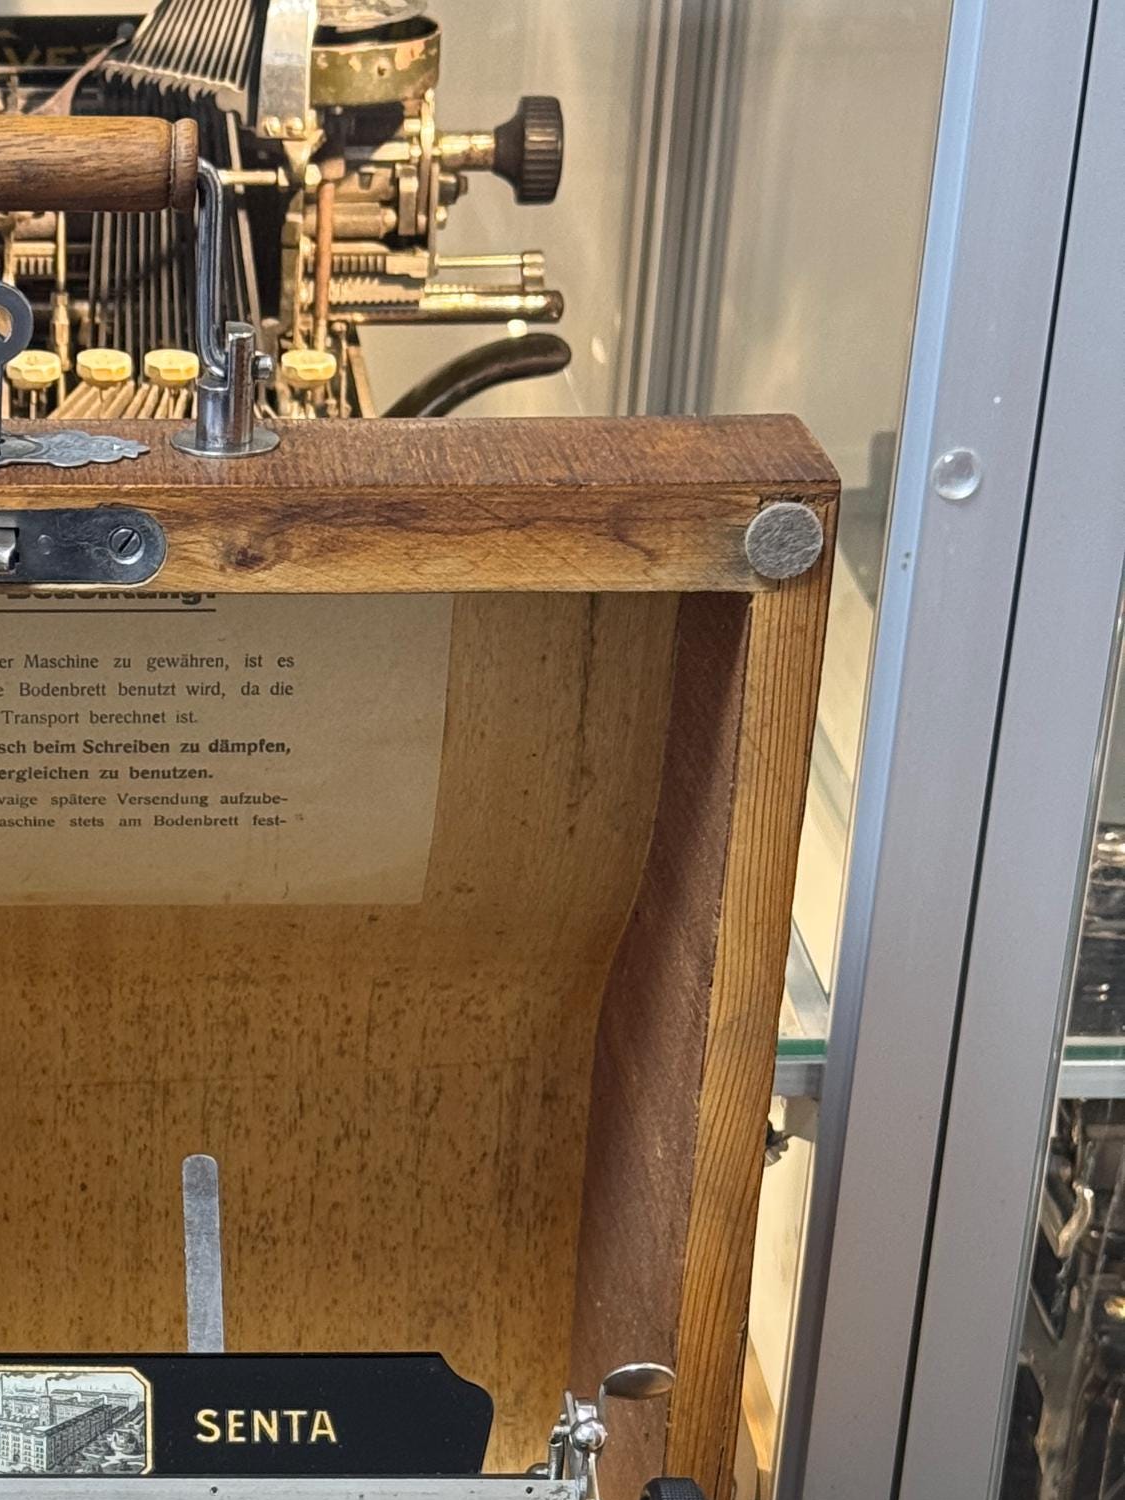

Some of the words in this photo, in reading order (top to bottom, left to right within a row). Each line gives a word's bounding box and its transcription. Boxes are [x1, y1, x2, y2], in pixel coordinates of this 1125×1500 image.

[23, 654, 99, 670] Maschine
[113, 658, 131, 670] zu
[146, 654, 230, 674] gewähren,
[244, 654, 263, 670] ist
[276, 656, 295, 670] es
[19, 682, 107, 699] Bodenbrett
[117, 682, 176, 698] benutzt
[185, 680, 226, 701] wird,
[240, 680, 261, 697] da
[269, 682, 294, 697] die
[0, 710, 80, 730] Transport
[89, 710, 167, 726] berechnet
[175, 711, 198, 725] ist.
[33, 740, 77, 755] beim
[82, 739, 170, 756] Schreiben
[179, 743, 201, 755] zu
[207, 739, 291, 758] dämpfen,
[98, 769, 119, 781] zu
[128, 766, 214, 781] benutzen.
[50, 794, 107, 810] spätere
[116, 793, 209, 809] Versendung
[219, 791, 288, 806] aufzube-
[69, 817, 105, 829] stets
[118, 819, 142, 828] am
[154, 815, 239, 828] Bodenbrett
[252, 815, 287, 828] fest-
[196, 1408, 337, 1443] SENTA
